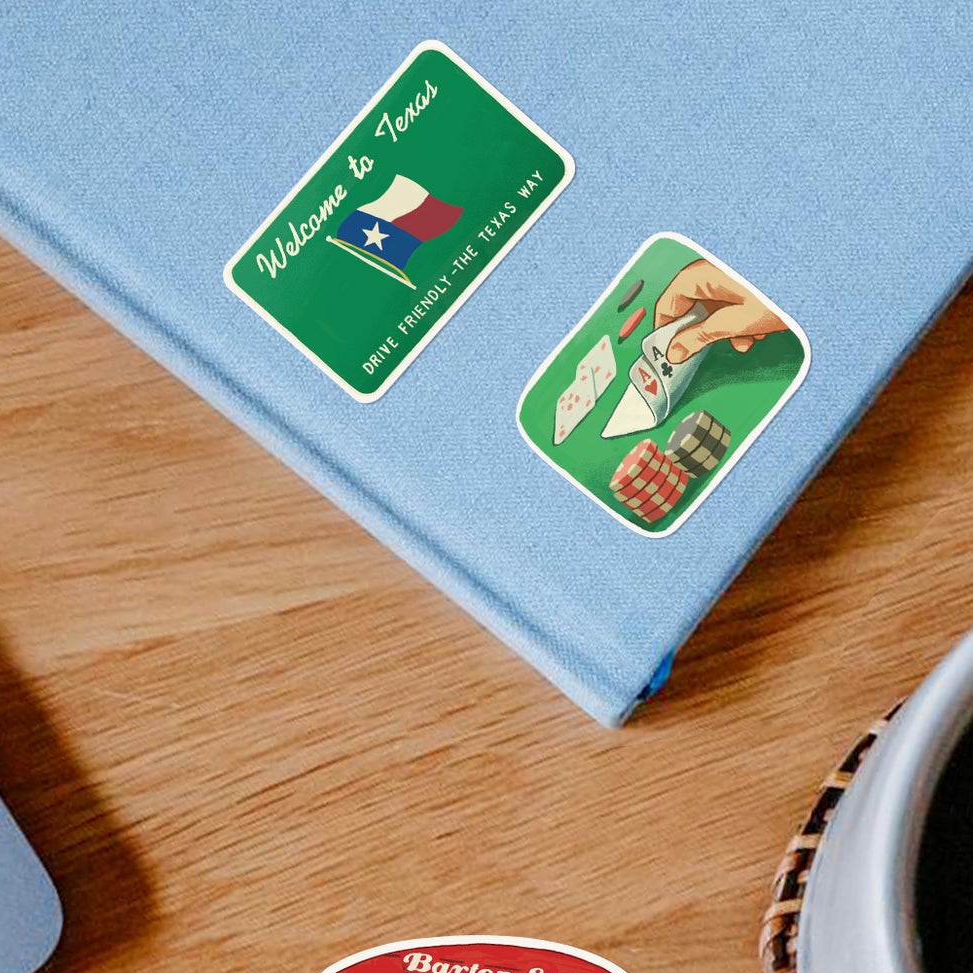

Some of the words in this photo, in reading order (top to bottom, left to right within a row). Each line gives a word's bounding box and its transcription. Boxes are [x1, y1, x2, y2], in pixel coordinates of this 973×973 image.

[256, 184, 347, 278] Welcome
[348, 155, 374, 180] to
[375, 80, 438, 142] Texas
[362, 336, 399, 375] DRIVE
[398, 276, 452, 335] FRIENDLY
[478, 202, 517, 243] TEXAS
[517, 170, 544, 199] WAY
[638, 367, 652, 382] A
[652, 346, 665, 361] A
